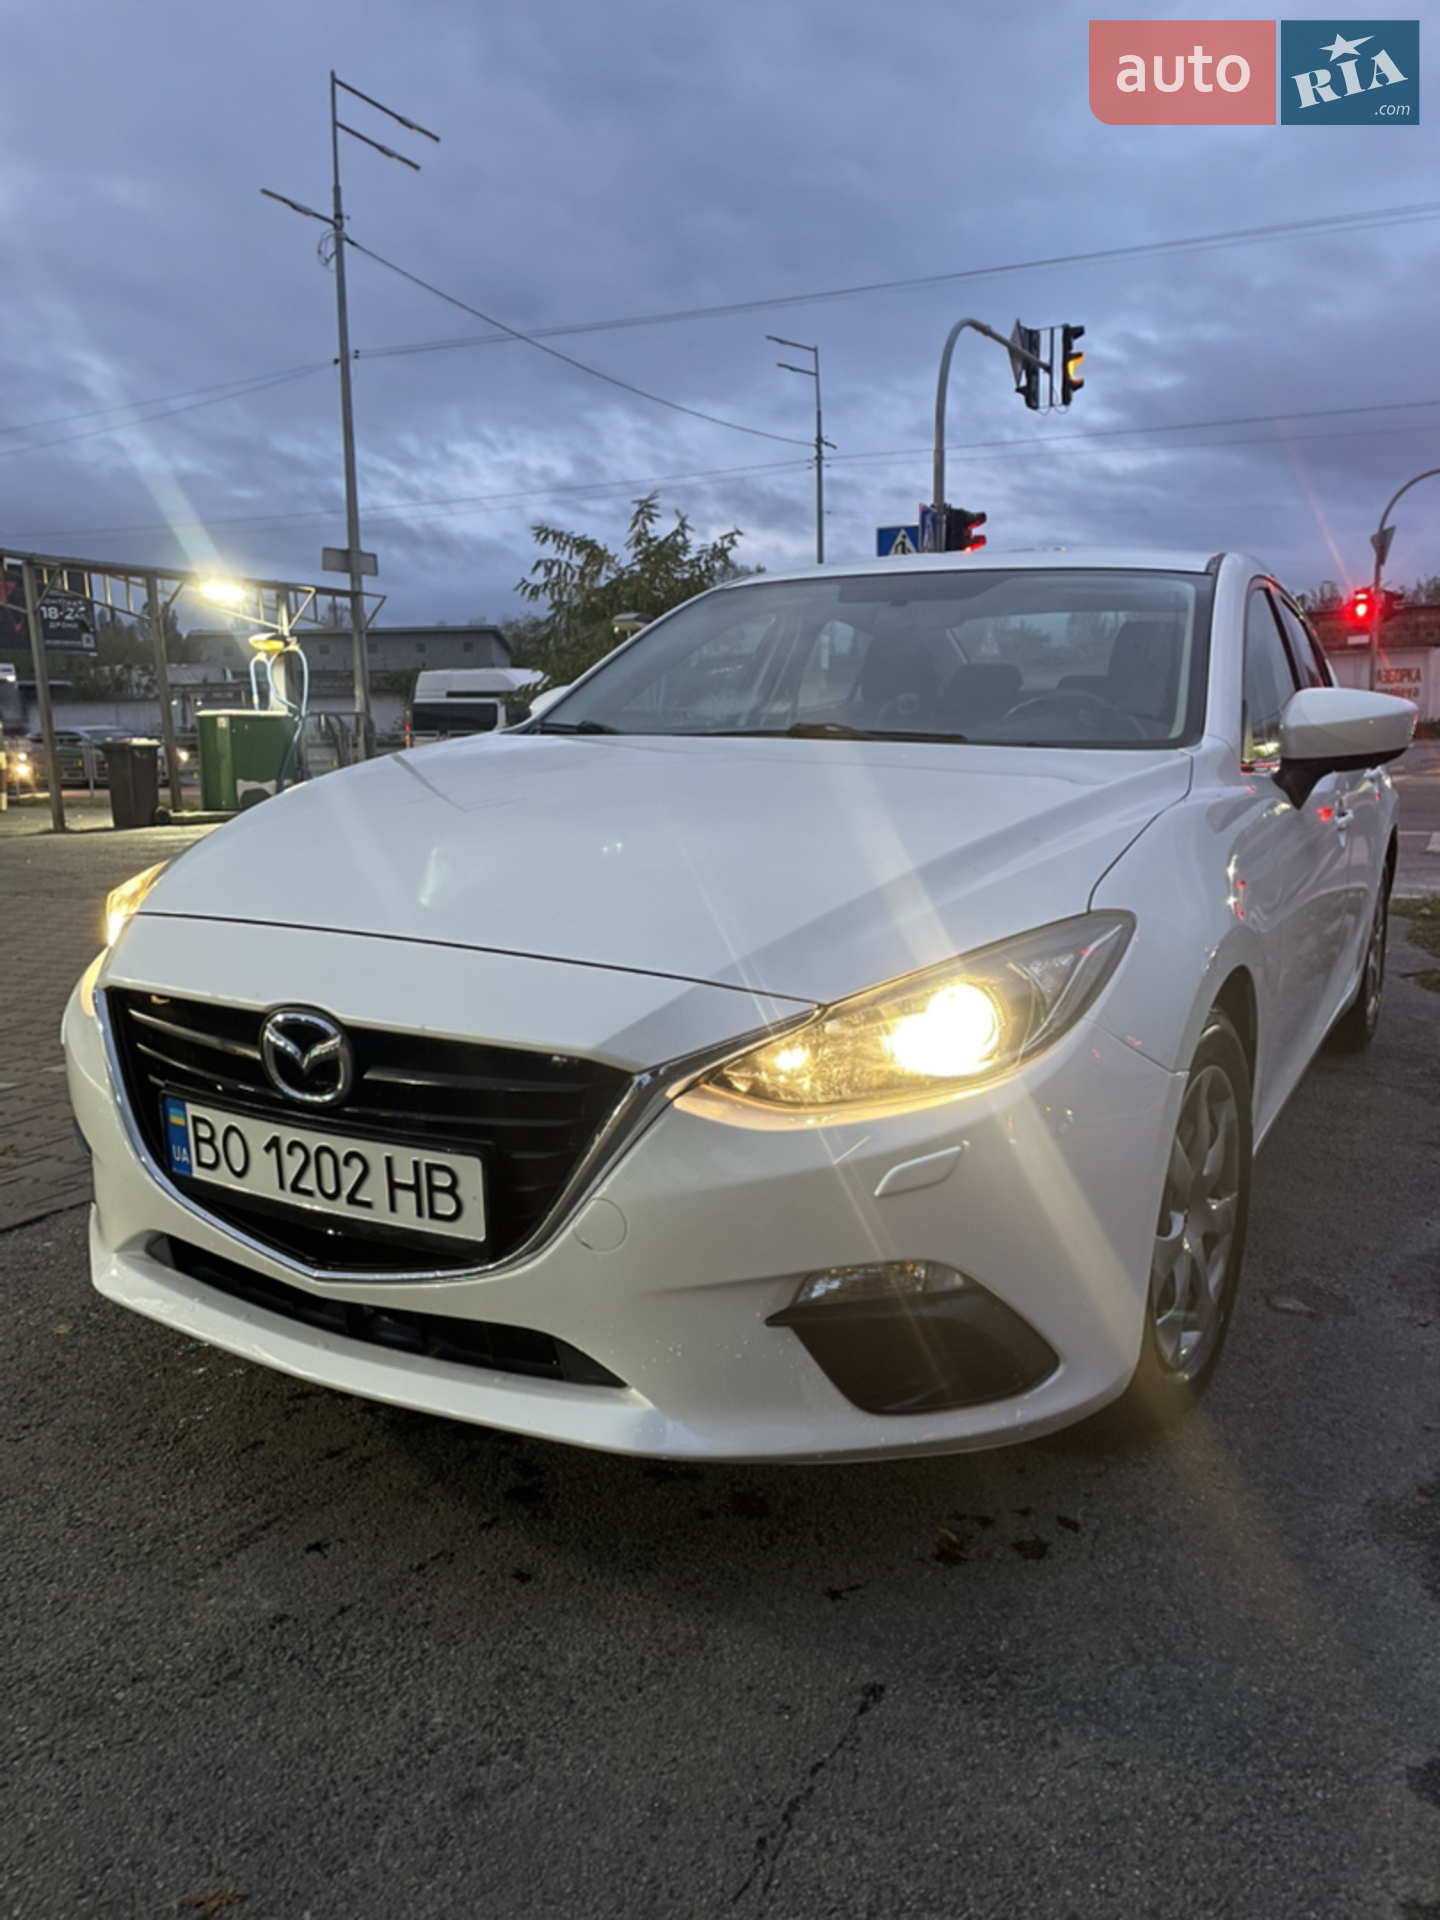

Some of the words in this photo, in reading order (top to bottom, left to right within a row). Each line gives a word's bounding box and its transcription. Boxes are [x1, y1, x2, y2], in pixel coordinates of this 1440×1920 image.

[1375, 667, 1422, 684] АЗБОРКА
[172, 1144, 191, 1164] UA
[191, 1113, 249, 1179] BO
[263, 1134, 373, 1209] 1202
[384, 1154, 464, 1224] HB
